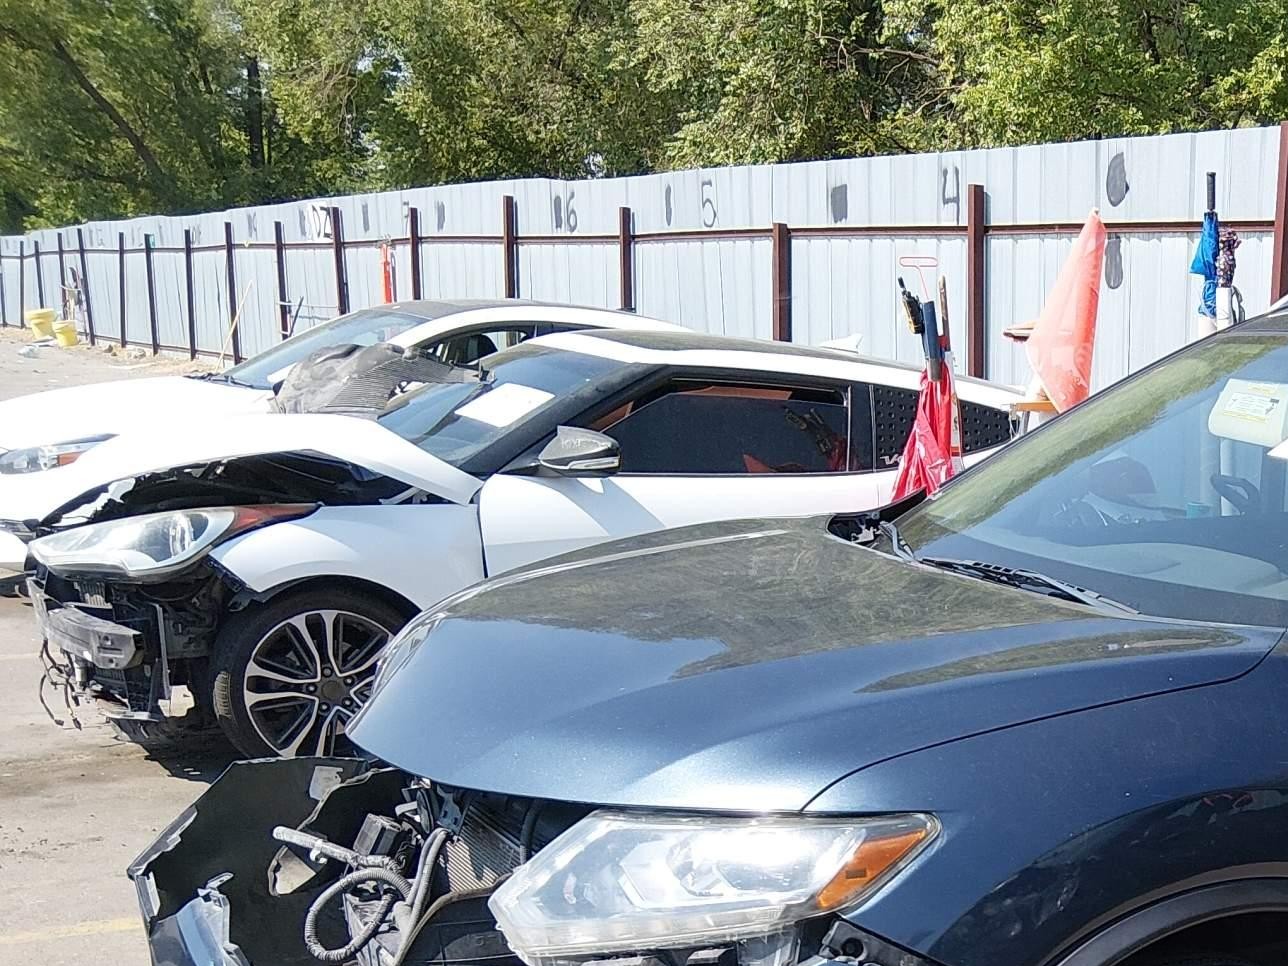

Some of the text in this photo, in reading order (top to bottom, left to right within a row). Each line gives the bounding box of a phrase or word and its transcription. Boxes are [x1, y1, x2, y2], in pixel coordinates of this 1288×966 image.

[566, 190, 578, 233] 6
[701, 179, 718, 228] 5
[942, 166, 961, 226] 4
